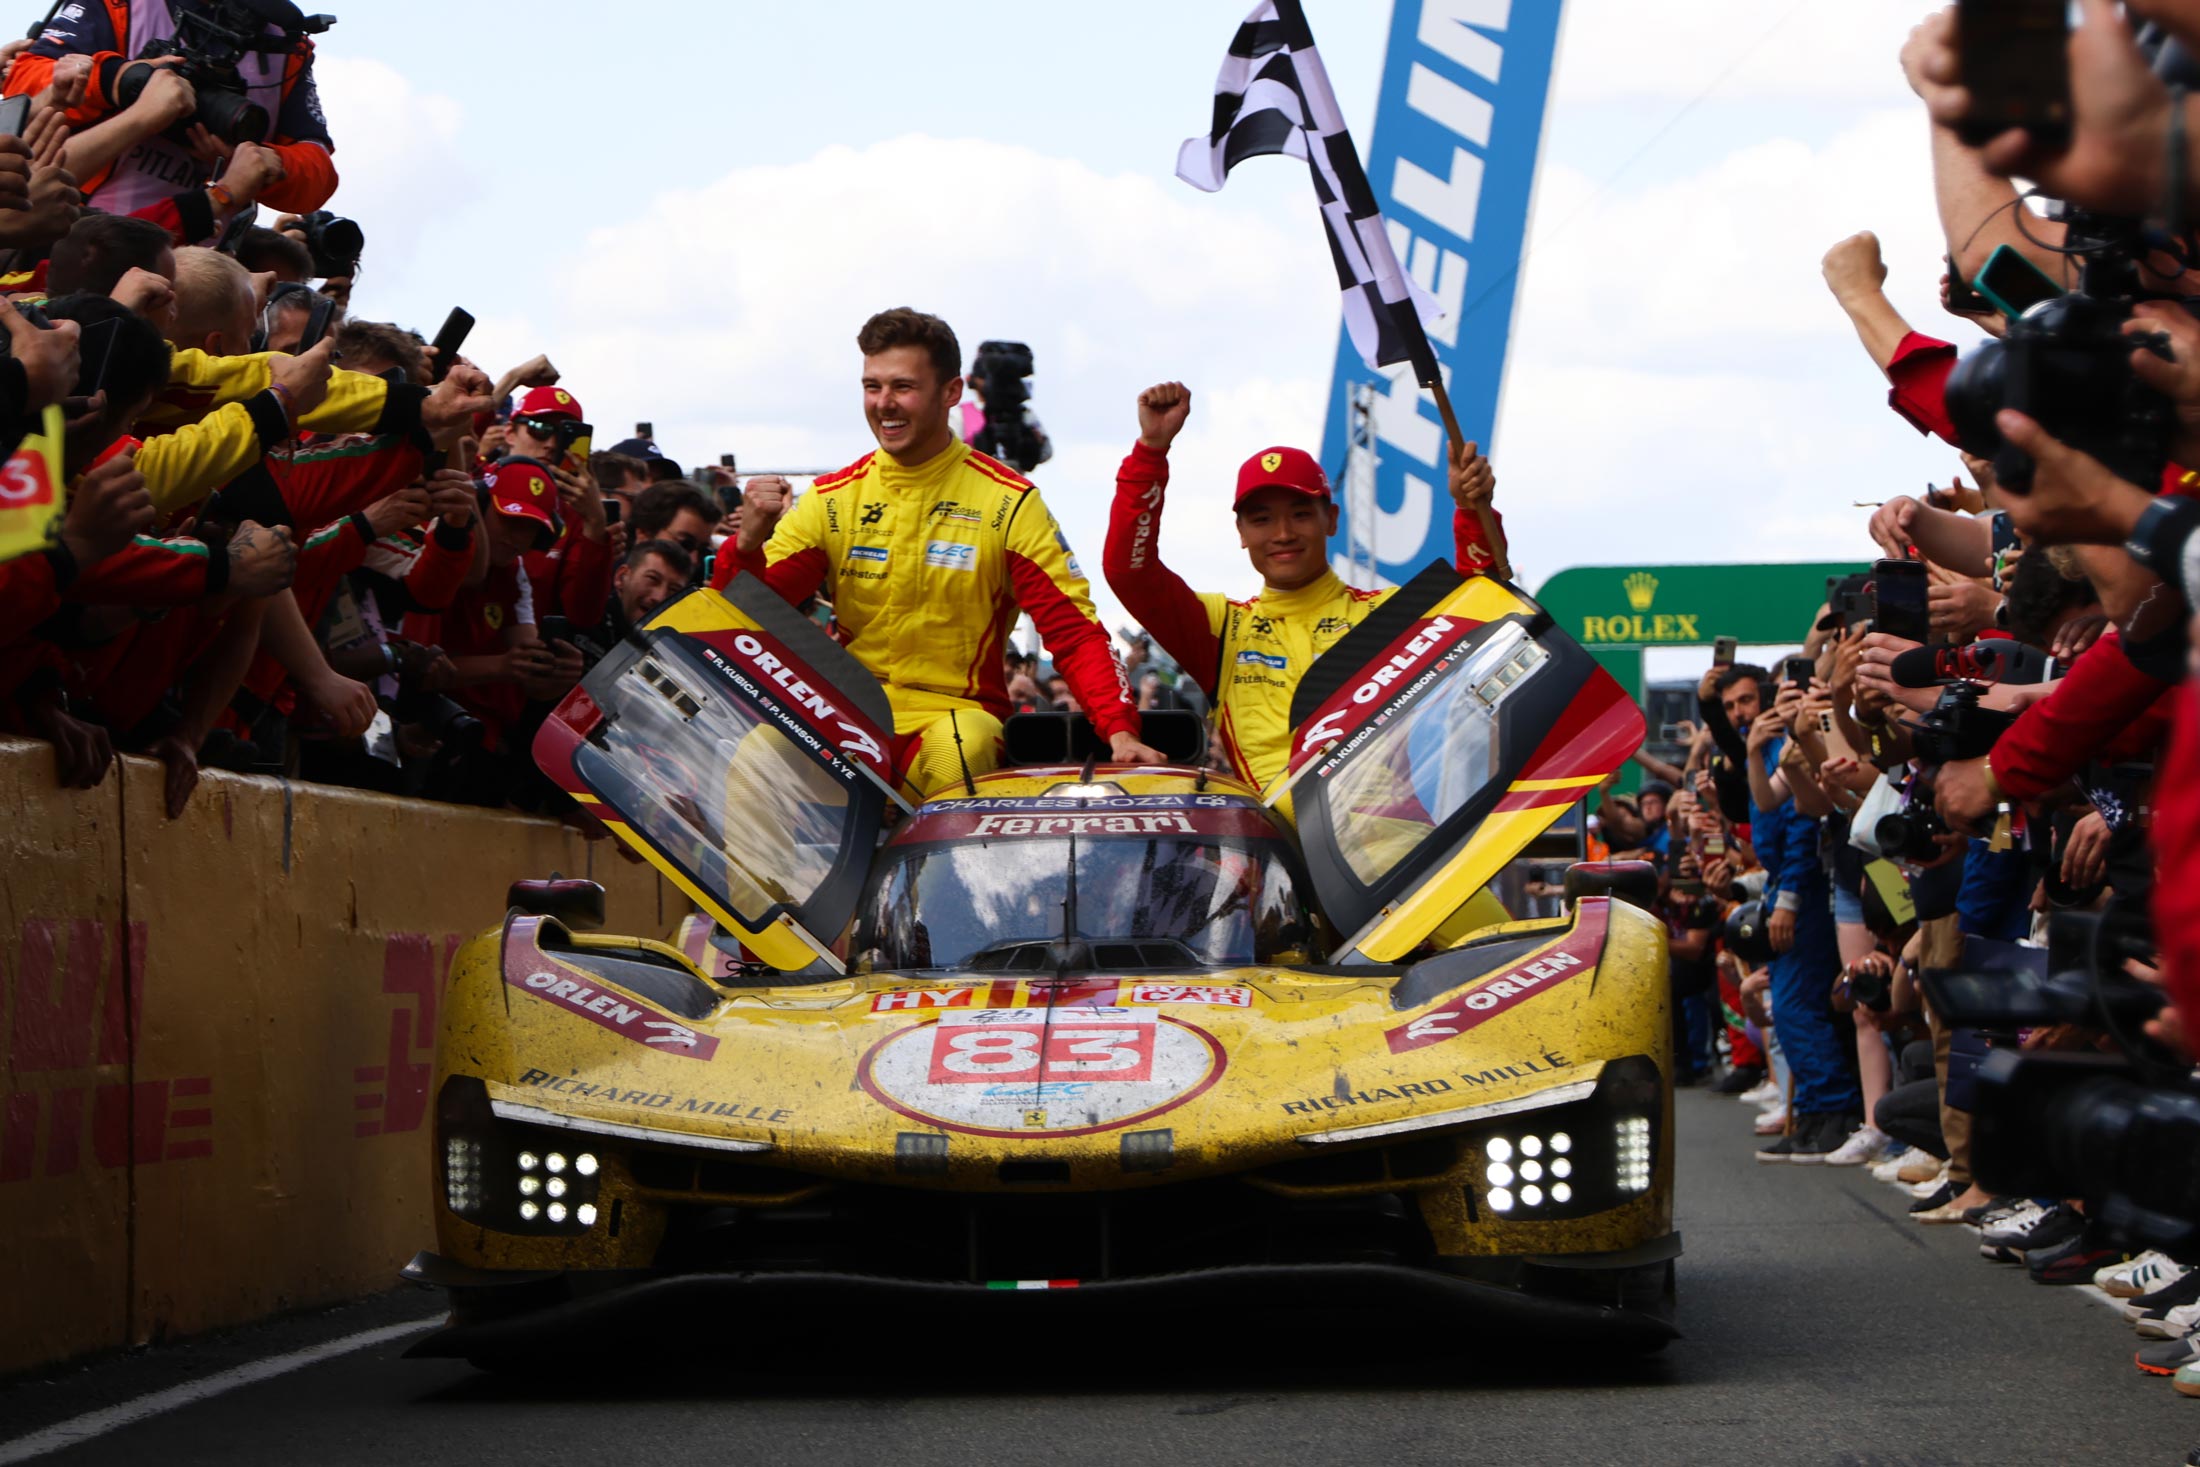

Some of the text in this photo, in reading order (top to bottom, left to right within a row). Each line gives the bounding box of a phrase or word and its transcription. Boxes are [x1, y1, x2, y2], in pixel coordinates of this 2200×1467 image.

[927, 543, 974, 560] WEC
[1128, 511, 1153, 569] ORLEN
[1583, 615, 1699, 641] ROLEX
[734, 634, 836, 720] ORLEN
[1352, 616, 1455, 704] ORLEN
[712, 656, 857, 780] R. KUBICA P. HANSON Y. YE
[1328, 639, 1472, 769] R. KUBICA P. HANSON Y. YE
[931, 796, 1183, 812] CHARLES POZZI
[966, 811, 1198, 837] Ferrari
[525, 972, 642, 1025] ORLEN
[876, 989, 967, 1011] HY
[1140, 990, 1242, 1005] CAR
[1465, 952, 1583, 1010] ORLEN
[942, 1029, 1141, 1074] 83
[518, 1068, 794, 1124] RICHARD MILLE
[981, 1082, 1094, 1097] WEC
[1281, 1050, 1572, 1116] RICHARD MILLE
